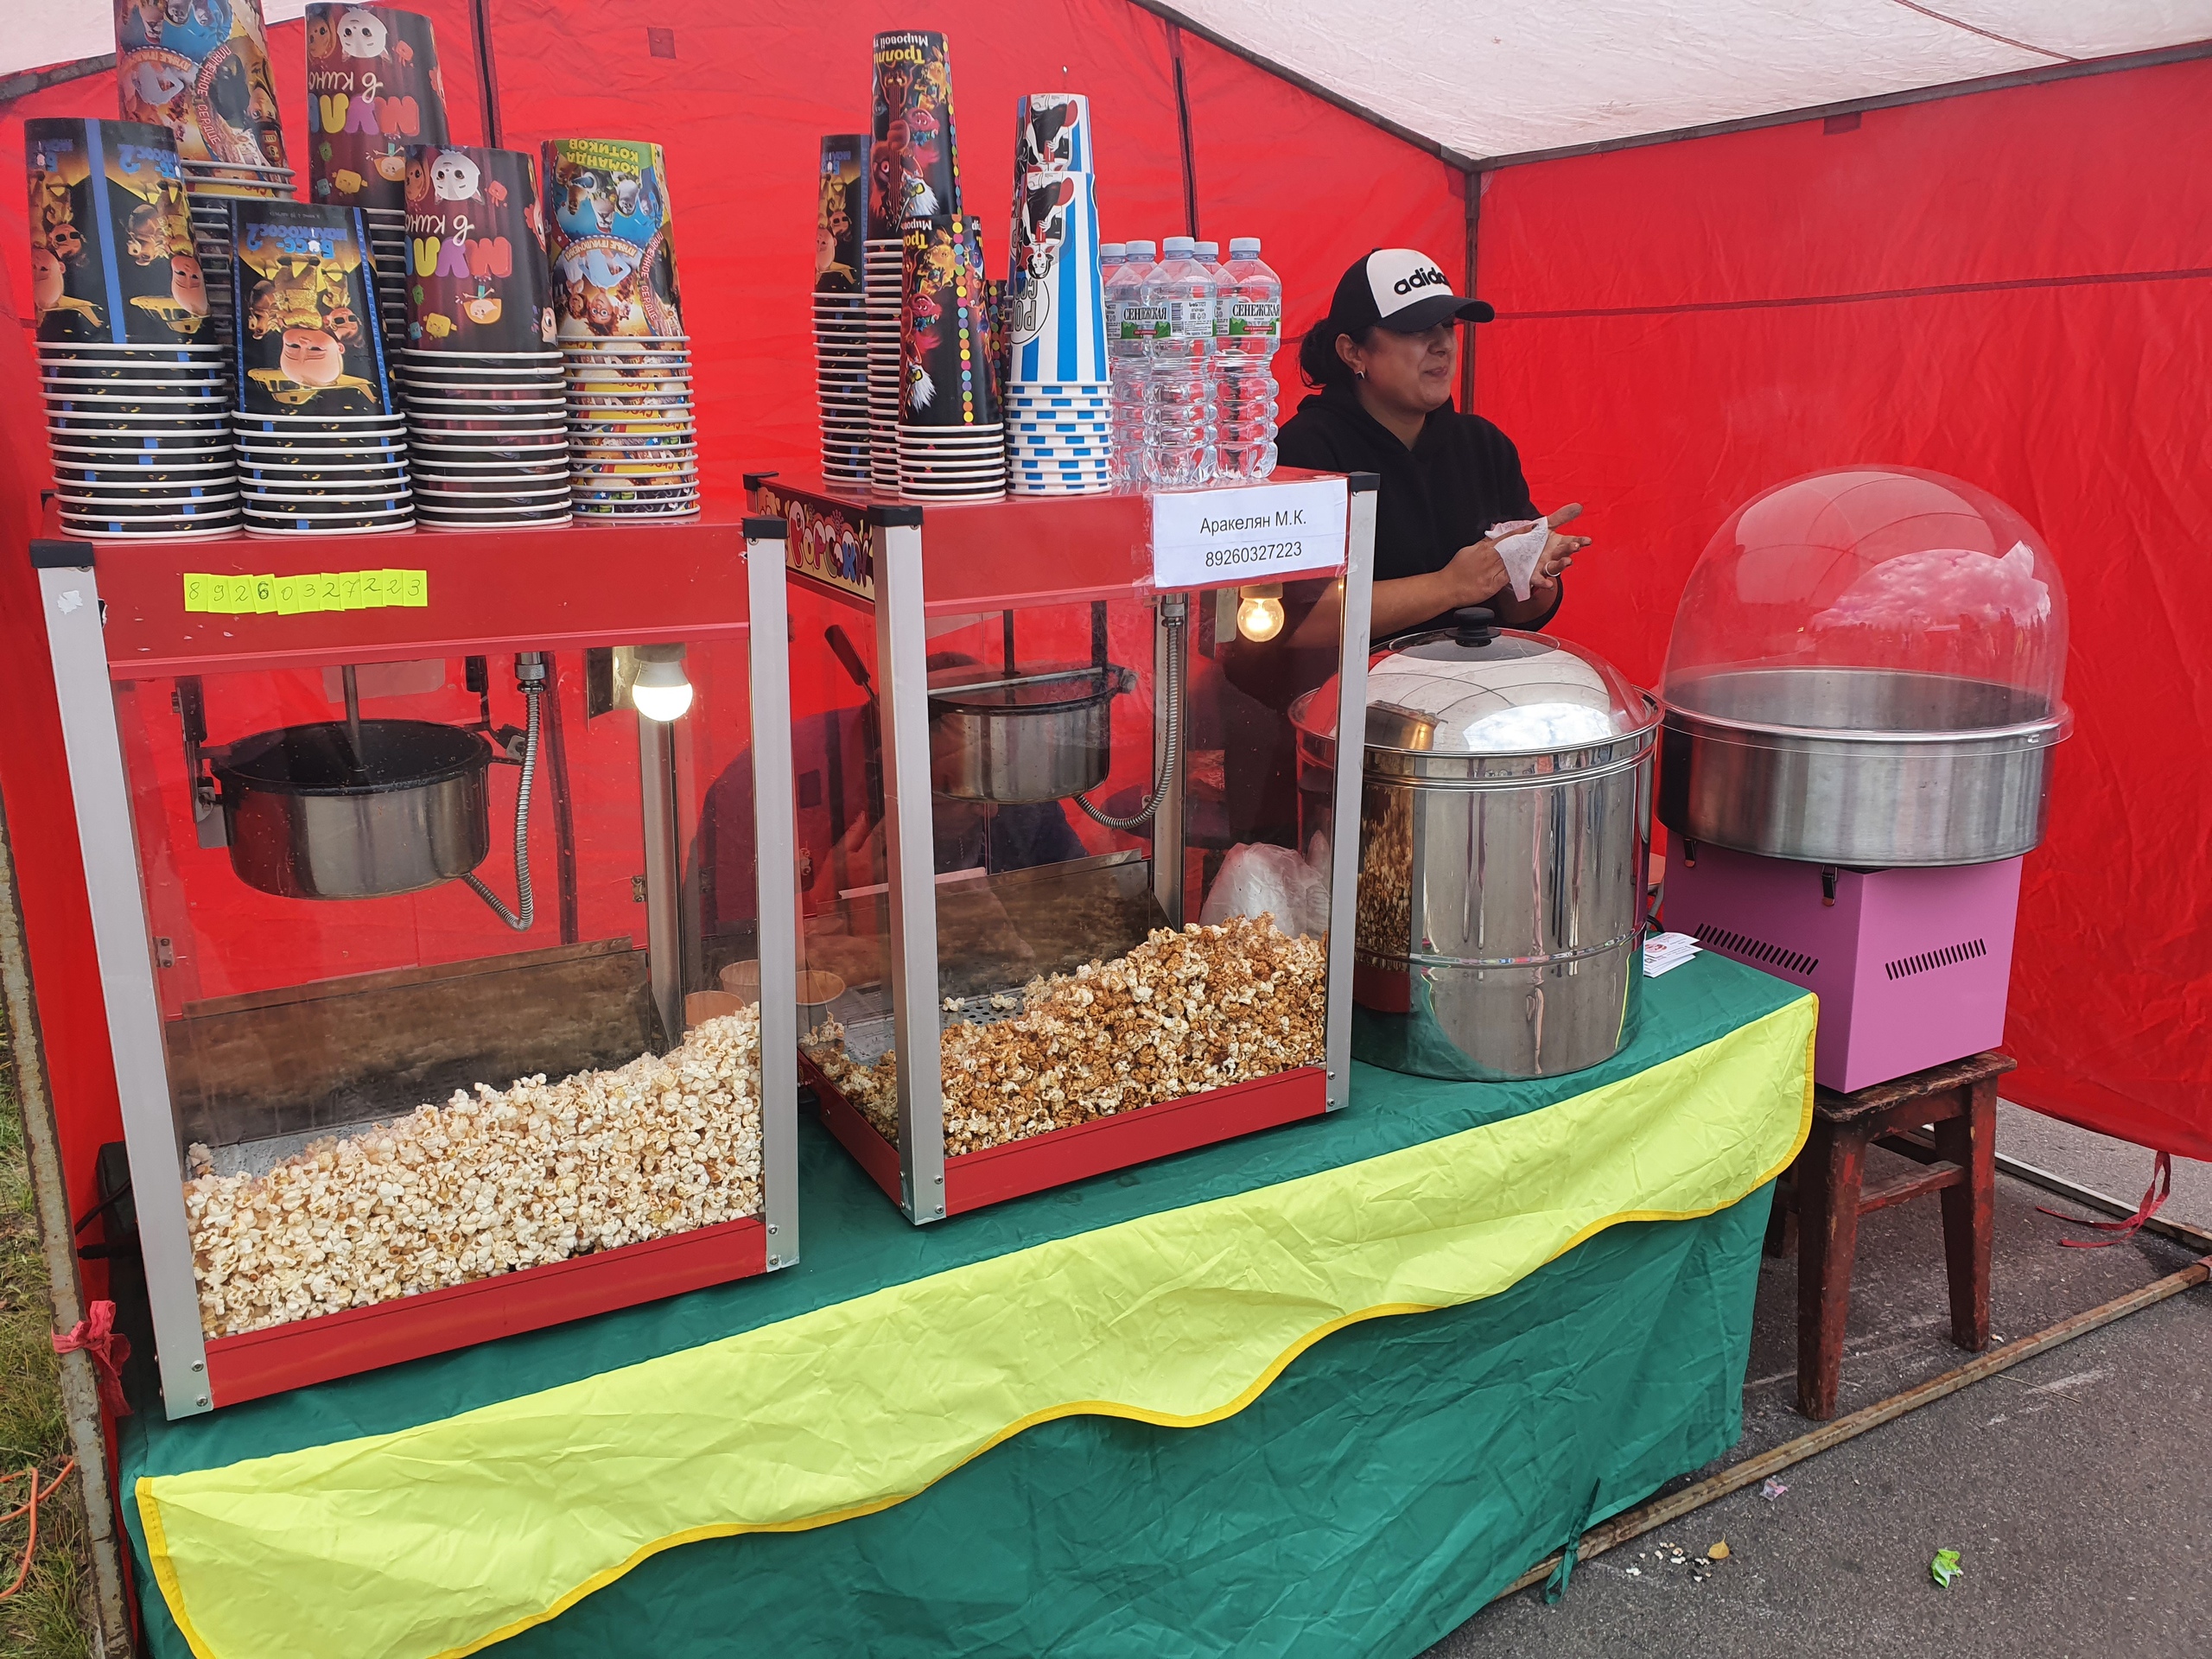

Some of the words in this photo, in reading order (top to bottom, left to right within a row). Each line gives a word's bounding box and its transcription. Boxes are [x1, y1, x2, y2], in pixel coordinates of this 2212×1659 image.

[568, 138, 639, 162] КОТИКОВ
[565, 151, 639, 176] КОМАНДА
[1199, 515, 1270, 537] Аракелян
[1275, 509, 1306, 526] М.К.
[1205, 541, 1302, 568] 89260327223
